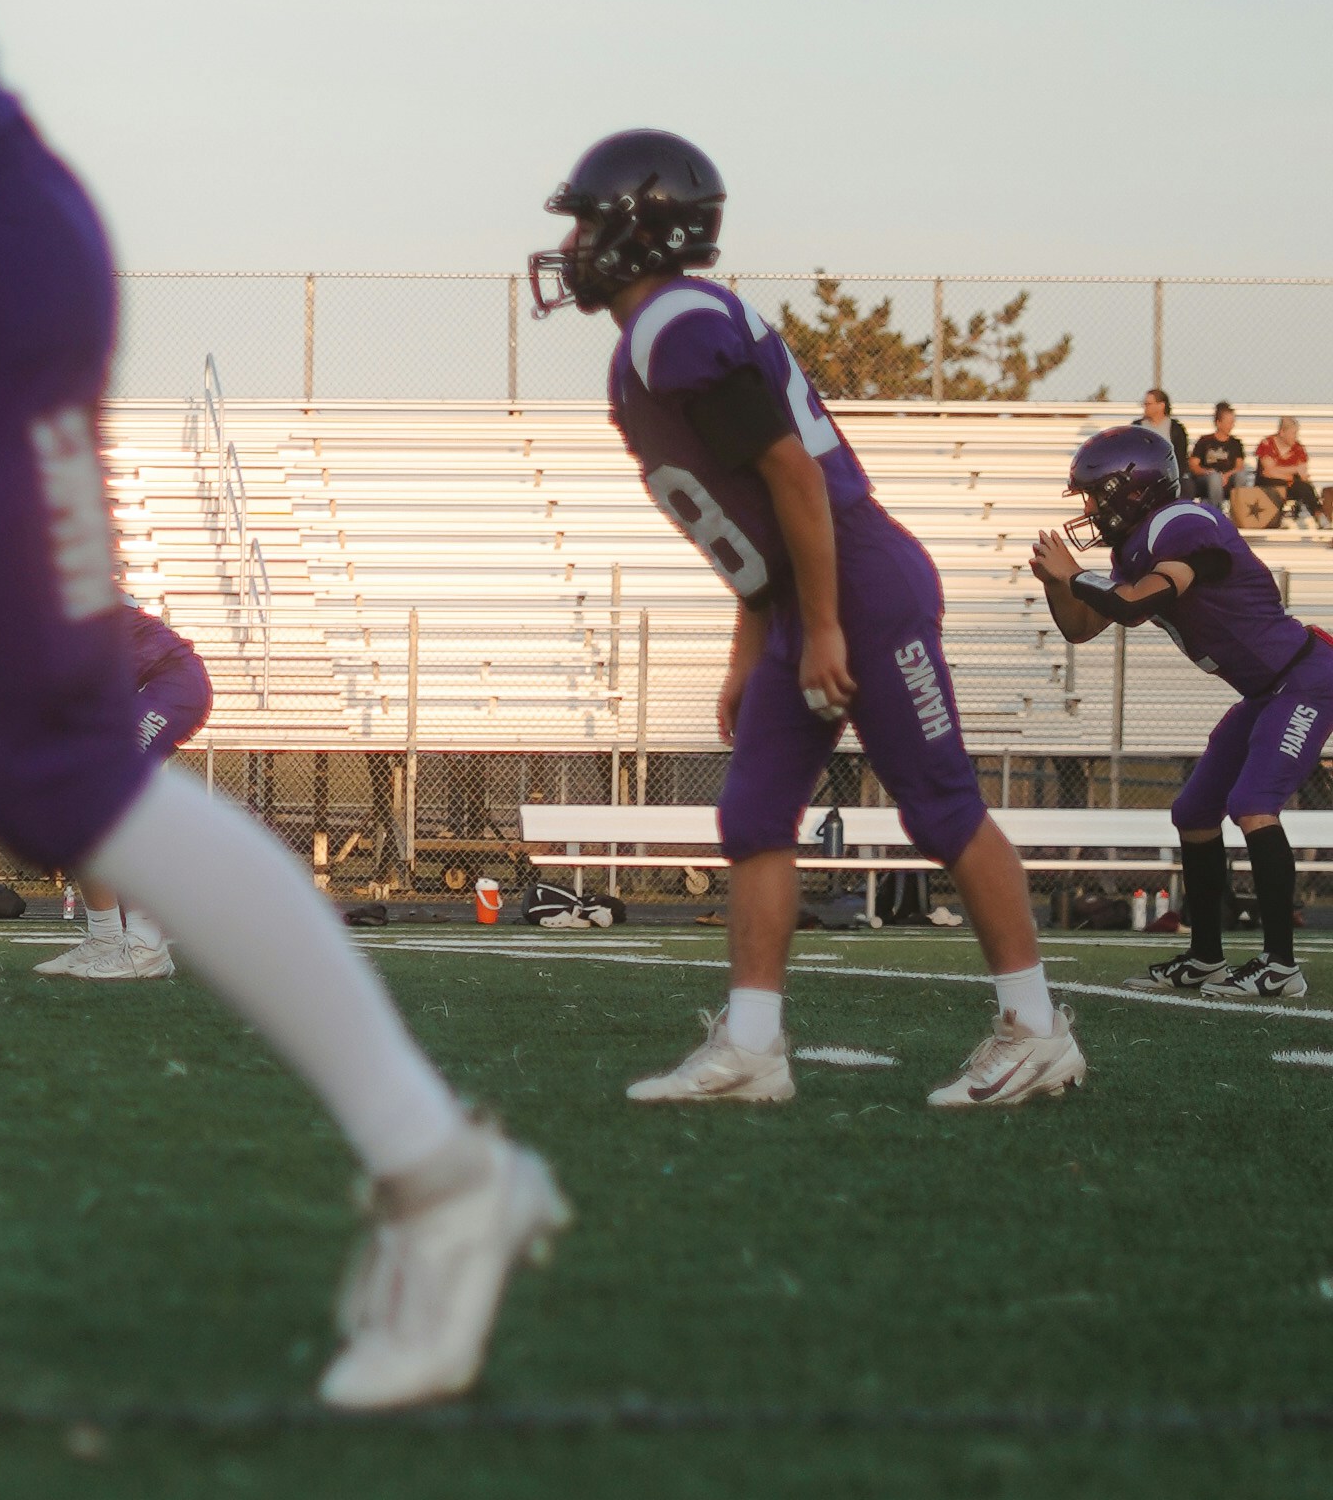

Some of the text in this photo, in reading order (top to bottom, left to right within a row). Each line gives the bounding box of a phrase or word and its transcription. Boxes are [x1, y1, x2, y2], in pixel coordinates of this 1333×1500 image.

[645, 464, 768, 598] 8
[895, 640, 952, 740] HAWKS
[1279, 704, 1318, 759] HAWKS
